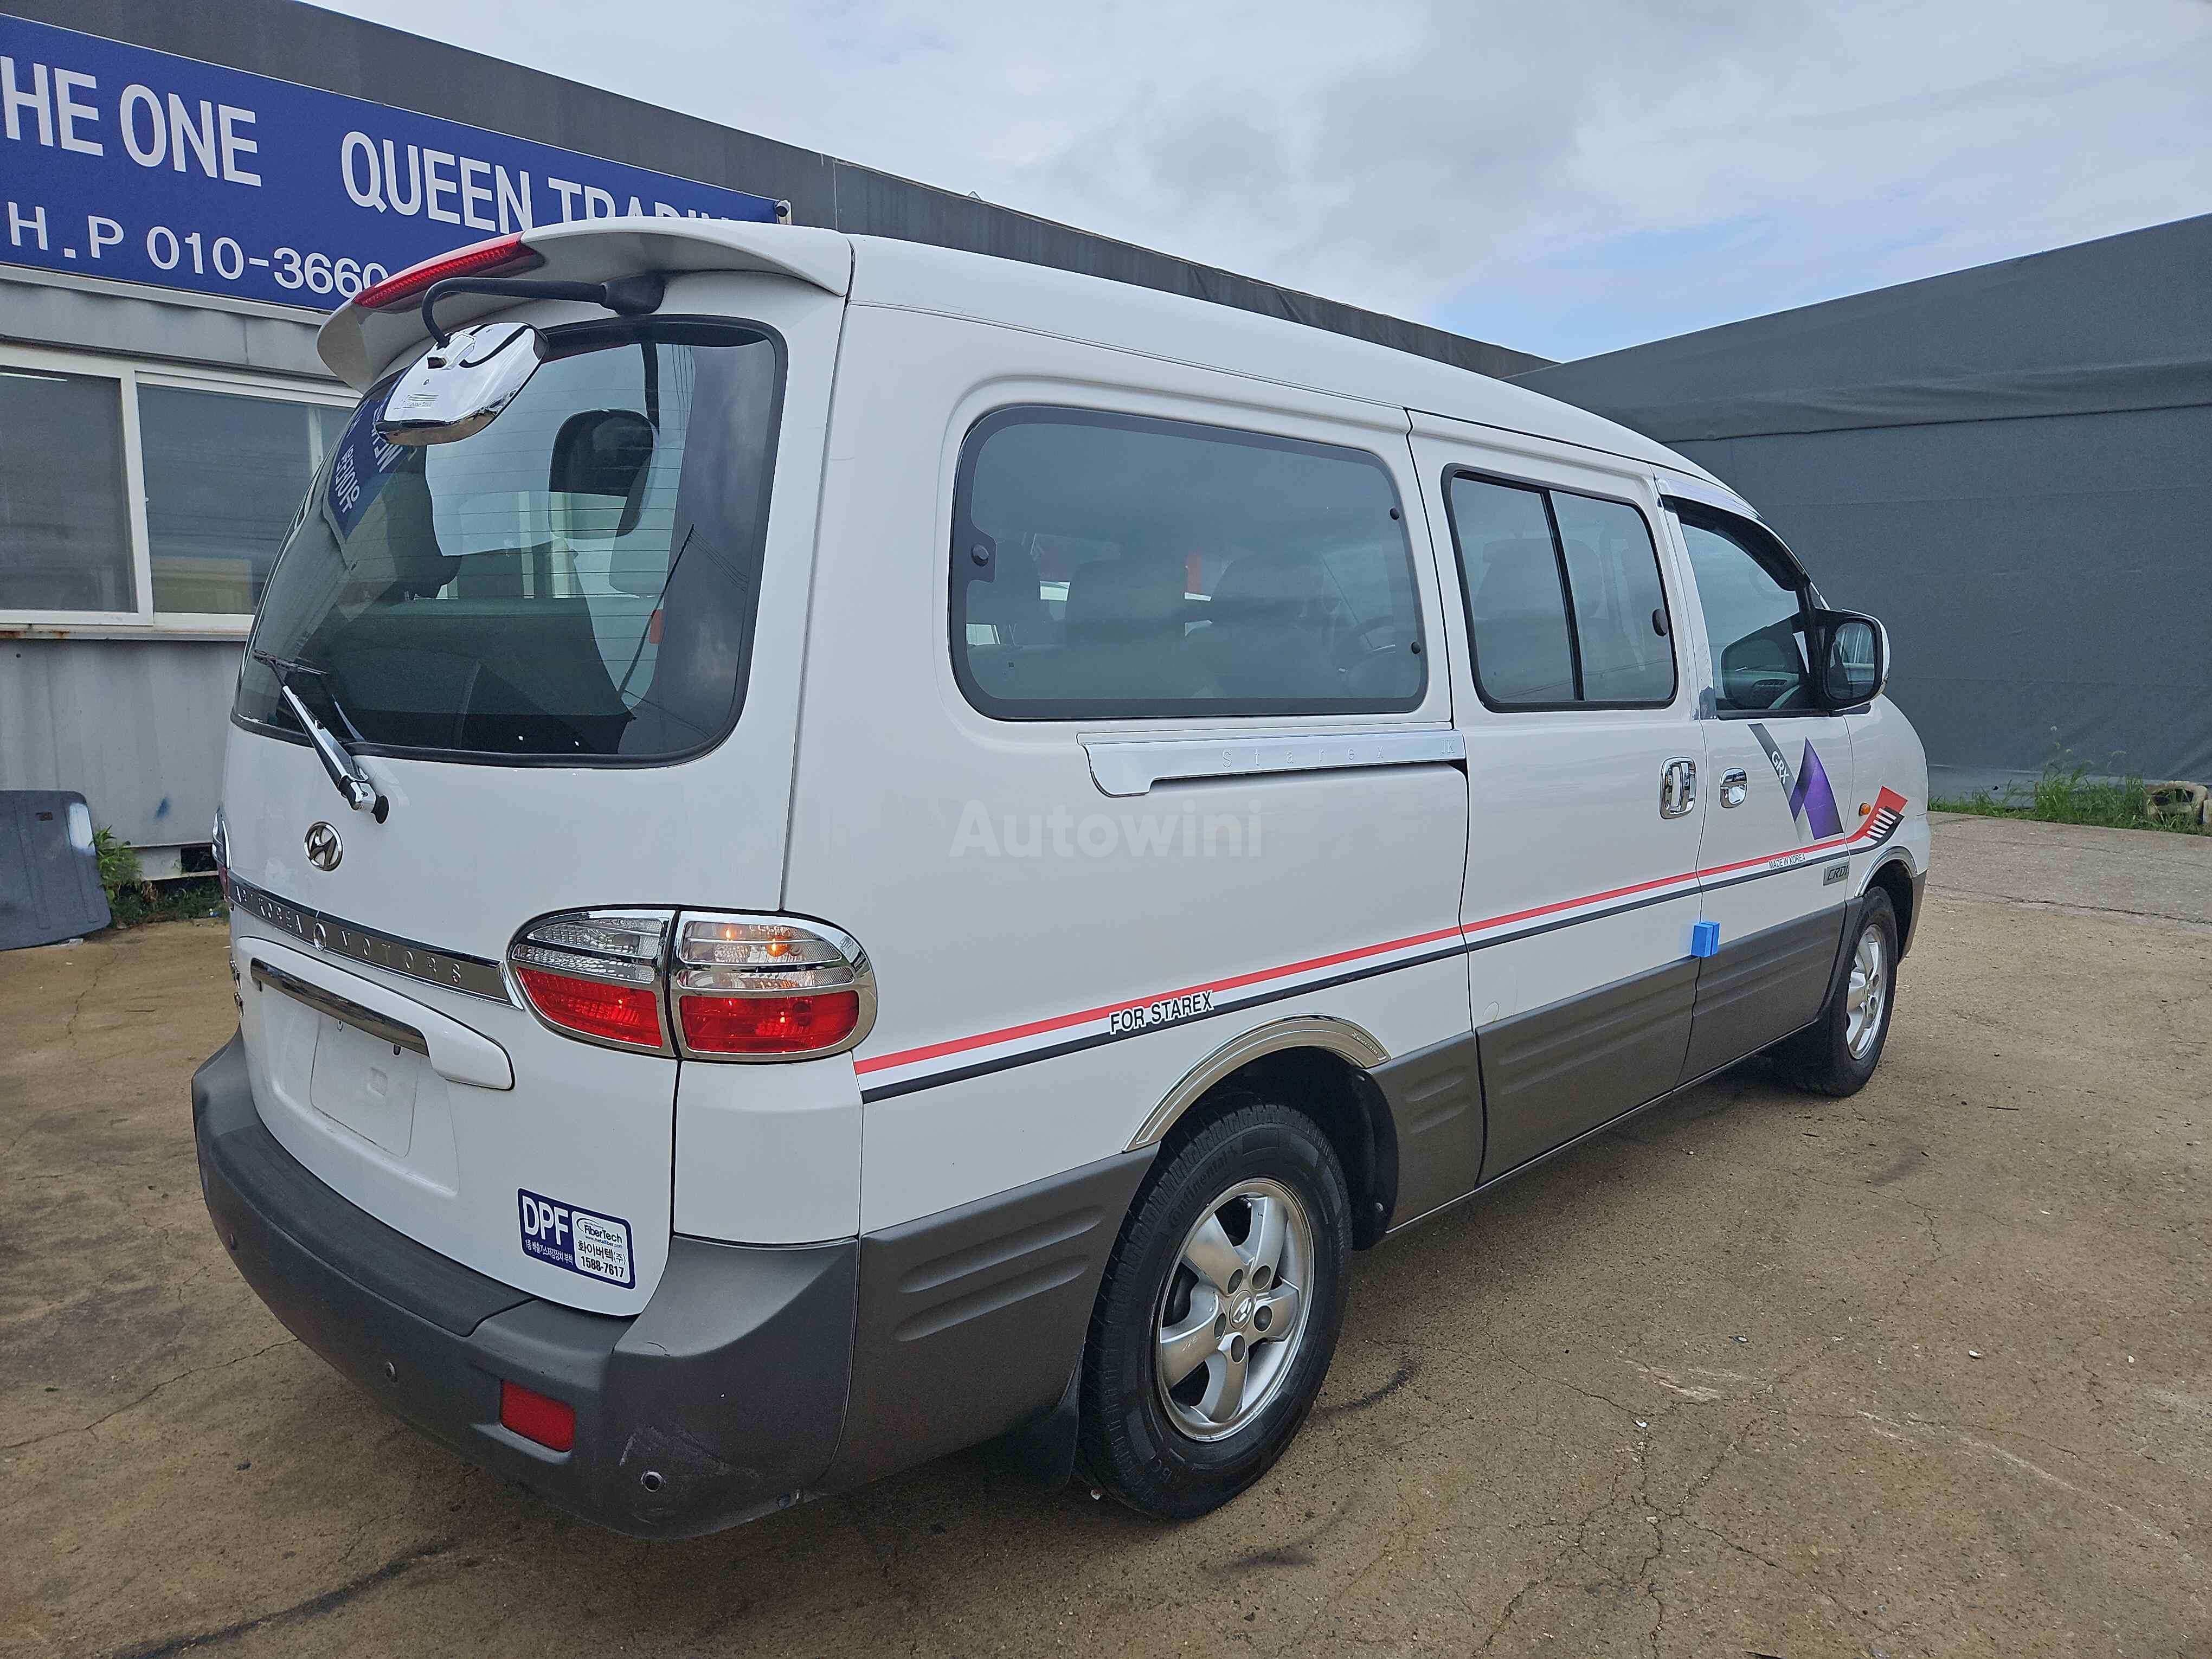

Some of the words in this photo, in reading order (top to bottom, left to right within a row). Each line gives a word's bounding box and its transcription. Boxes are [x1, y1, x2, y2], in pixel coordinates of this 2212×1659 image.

[120, 83, 262, 187] ONE
[341, 131, 533, 234] QUEEN
[1222, 745, 1384, 768] Starex
[1771, 751, 1790, 785] GRX
[1769, 858, 1783, 869] MADE
[1783, 858, 1789, 866] IN
[1789, 854, 1806, 865] KOREA
[258, 897, 303, 934] KOREA
[341, 930, 461, 983] MOTORS
[1110, 1007, 1145, 1033] FOR
[1150, 991, 1213, 1023] STAREX
[522, 1195, 569, 1245] DPF
[584, 1224, 622, 1244] FiberTech
[581, 1256, 625, 1278] 1588-7617
